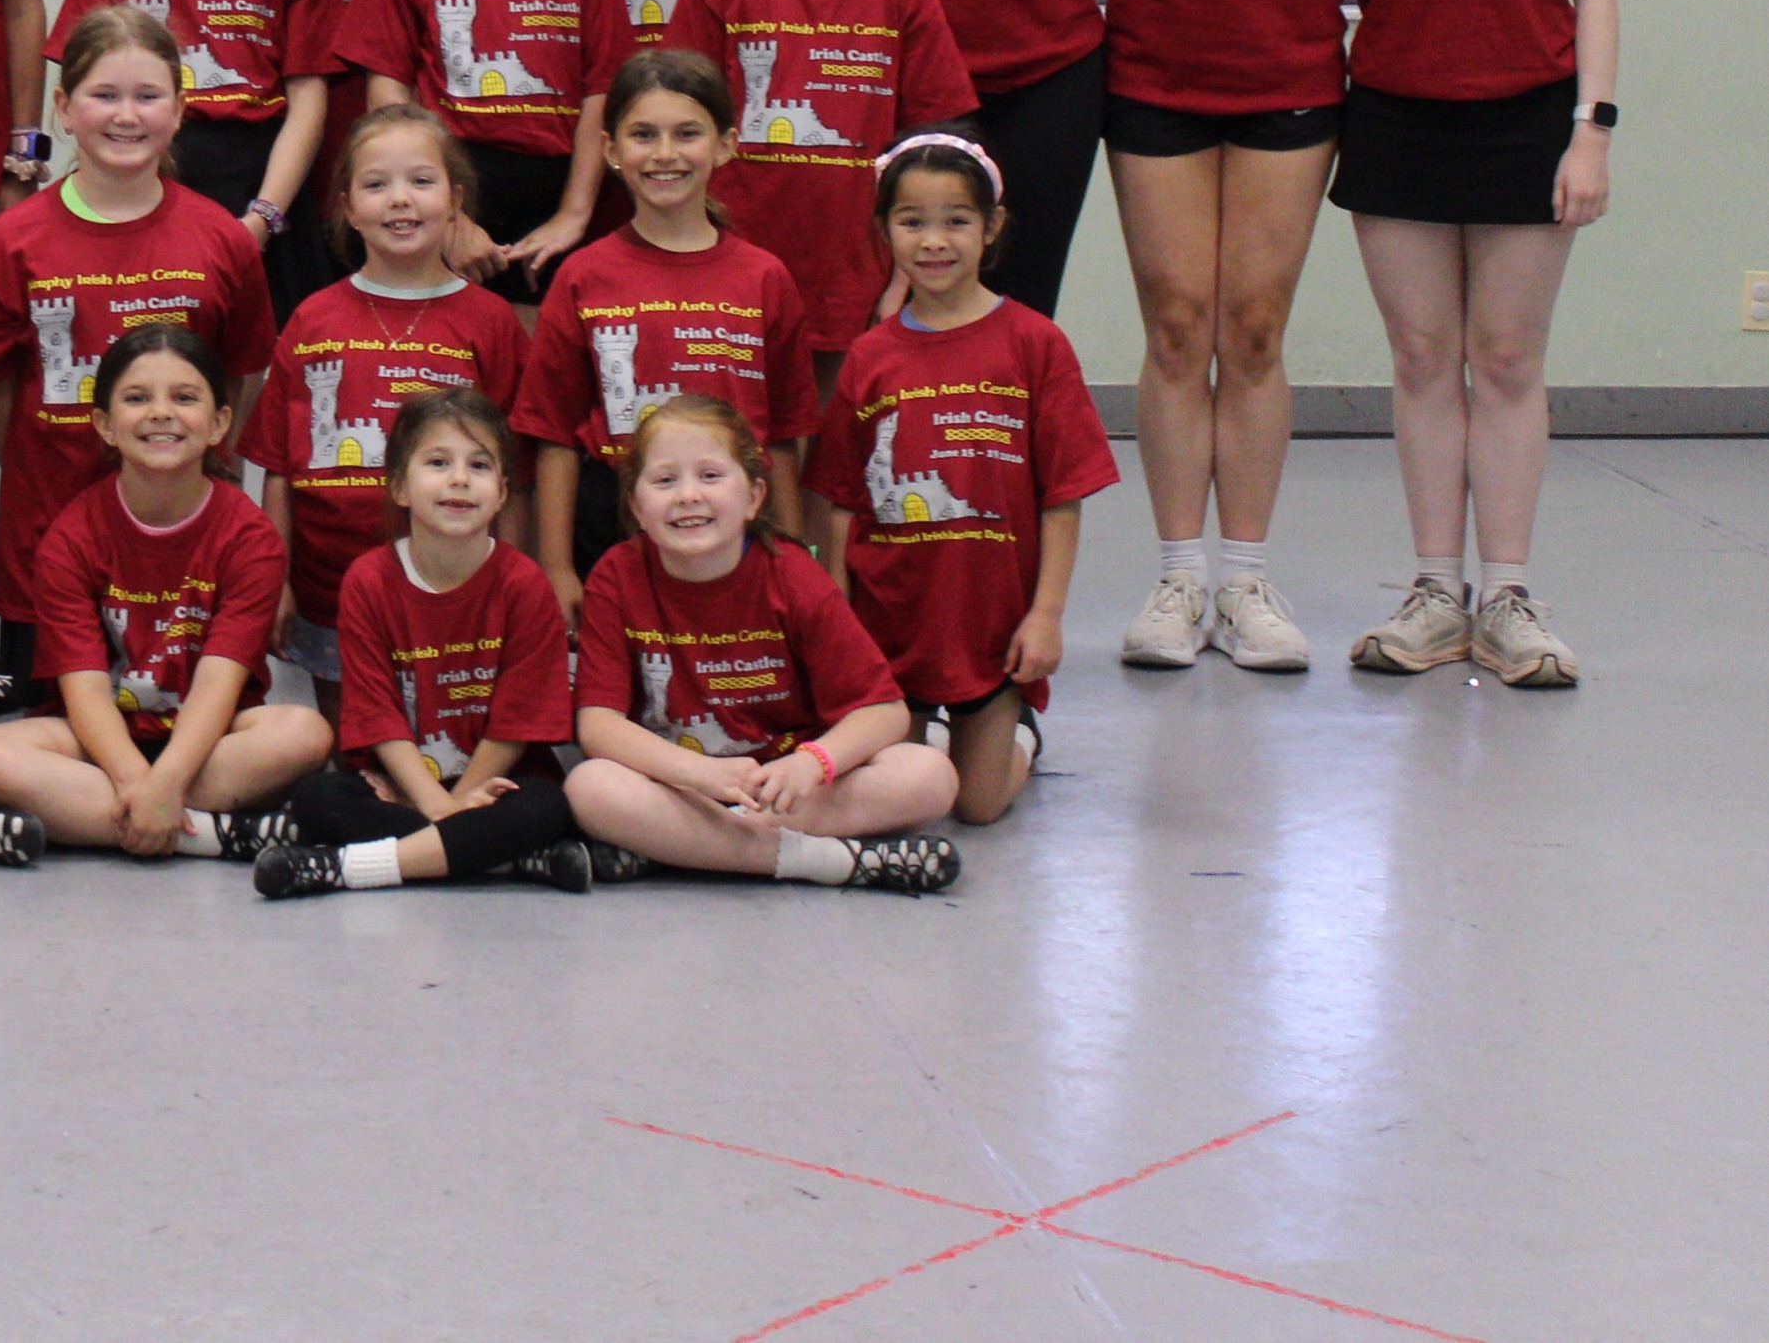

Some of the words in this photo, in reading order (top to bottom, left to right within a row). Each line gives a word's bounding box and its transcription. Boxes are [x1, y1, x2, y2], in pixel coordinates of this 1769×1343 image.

[77, 274, 112, 285] Irish
[116, 273, 148, 285] Arts
[152, 269, 206, 281] Center
[110, 299, 146, 313] Irish
[148, 295, 200, 308] Castles
[639, 301, 676, 312] Irish
[680, 301, 715, 312] Arts
[673, 327, 713, 339] Irish
[349, 339, 385, 350] Irish
[378, 366, 416, 378] Irish
[419, 368, 475, 388] Castles
[940, 383, 976, 395] Arts
[933, 412, 971, 425] Irish
[695, 661, 732, 674] Irish
[734, 656, 785, 672] Castles
